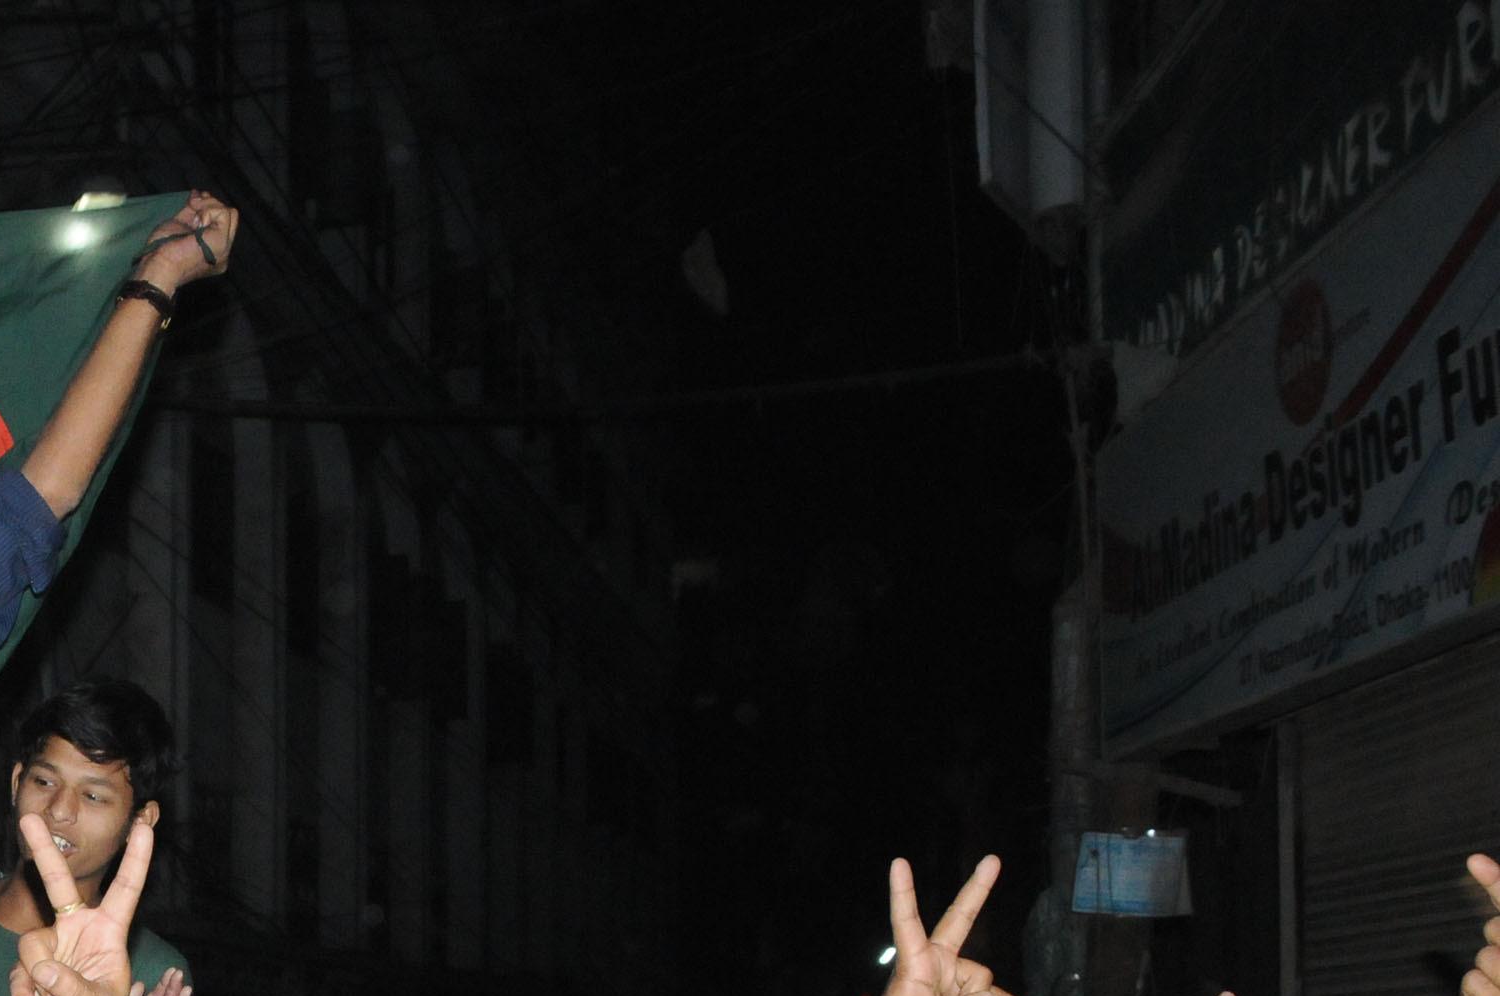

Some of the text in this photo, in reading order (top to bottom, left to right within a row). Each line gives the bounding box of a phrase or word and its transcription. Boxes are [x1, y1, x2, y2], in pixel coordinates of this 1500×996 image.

[1264, 378, 1425, 543] Designer
[1437, 326, 1500, 442] Fu
[1347, 520, 1424, 575] Modern
